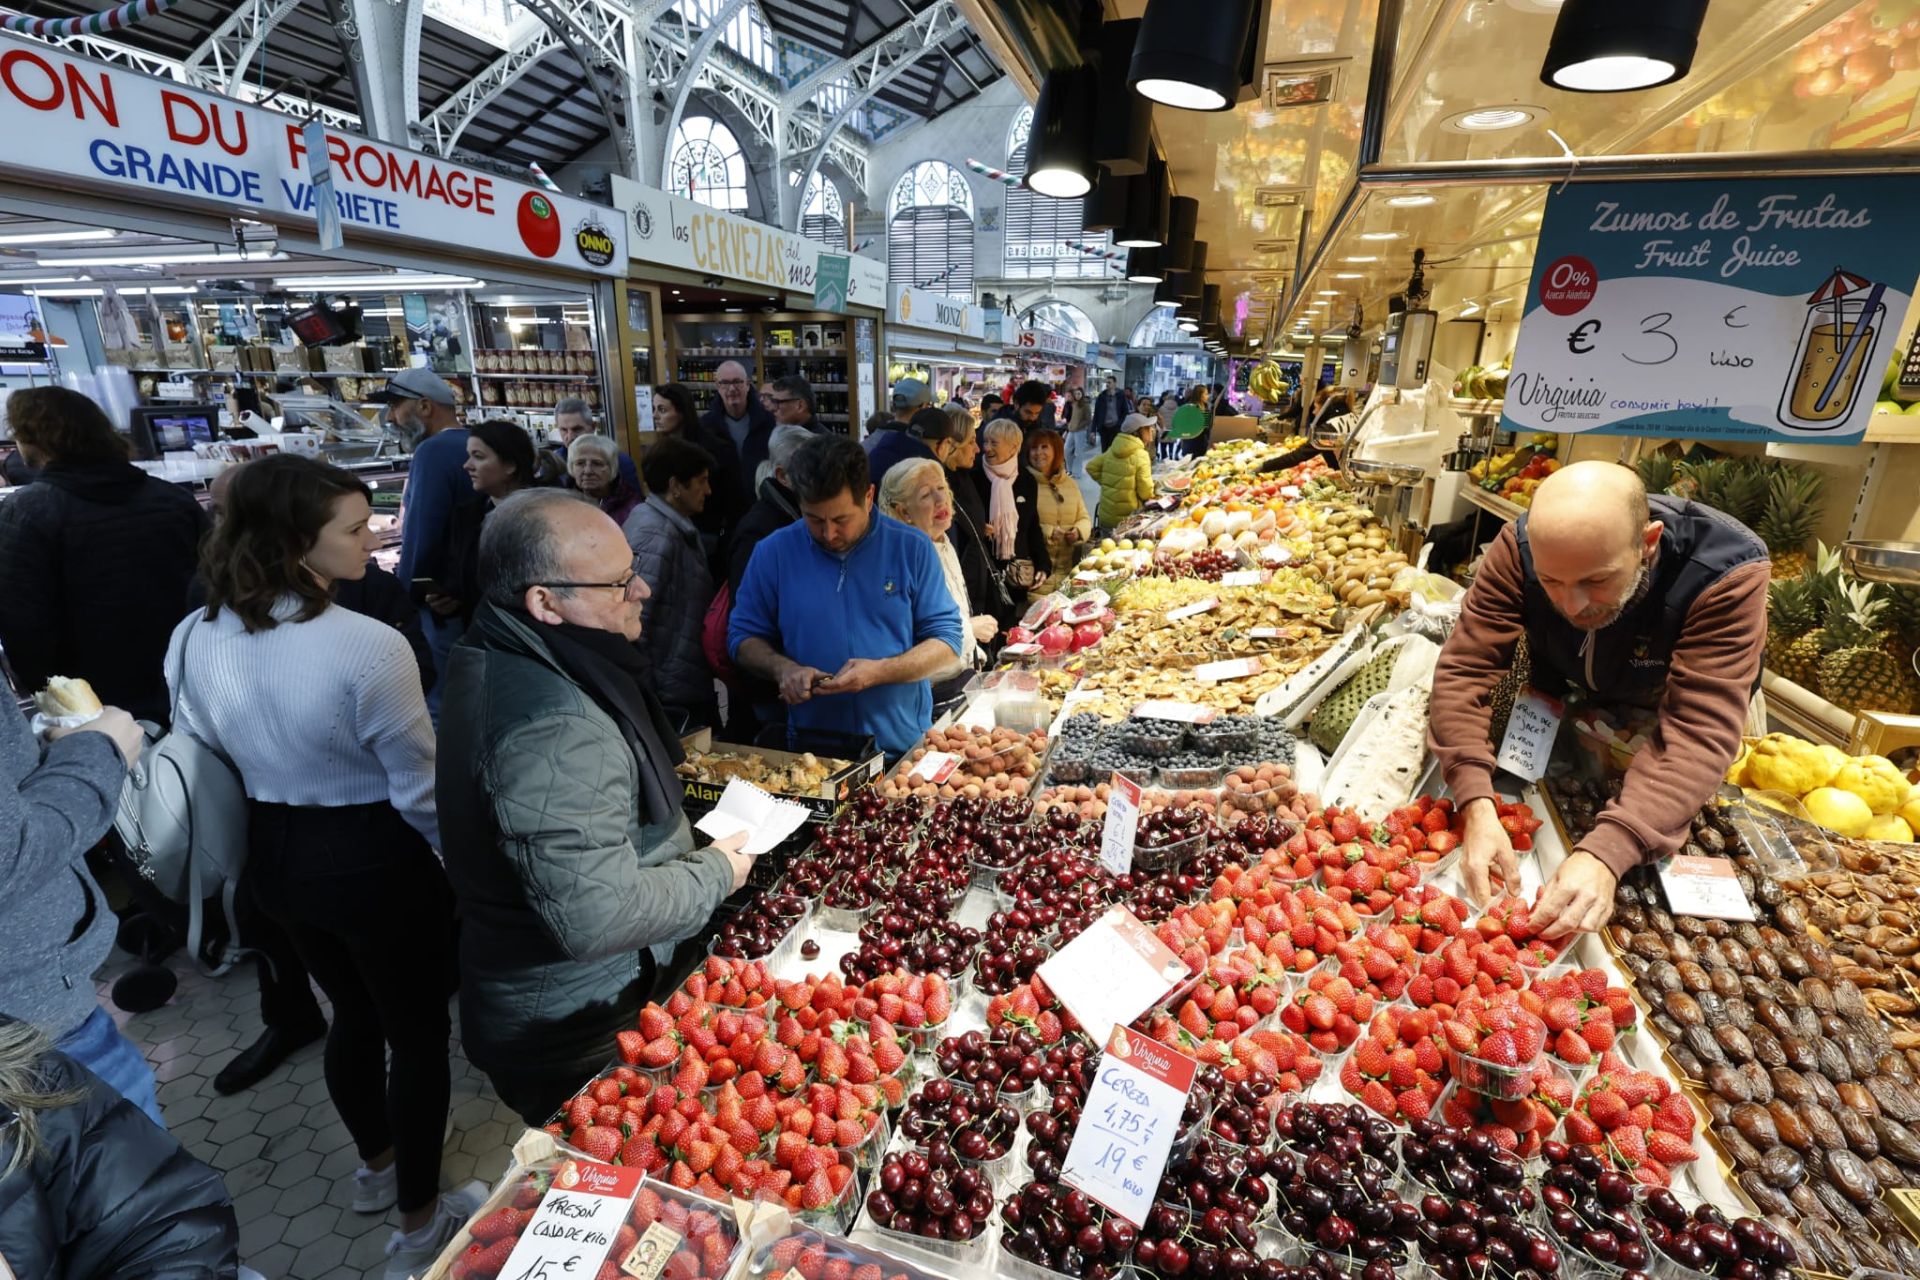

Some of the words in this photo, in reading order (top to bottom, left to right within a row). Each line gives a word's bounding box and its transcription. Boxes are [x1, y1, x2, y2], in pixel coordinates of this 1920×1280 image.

[161, 90, 248, 156] DU
[286, 124, 495, 216] FROMAGE
[89, 139, 264, 203] GRANDE
[1589, 201, 1692, 232] Zumos
[1698, 193, 1741, 231] de
[1747, 193, 1872, 232] Frutas
[579, 232, 612, 253] ONNO
[669, 201, 689, 242] las
[691, 213, 785, 286] CERVEZAS
[785, 240, 801, 261] del
[1635, 239, 1711, 269] Fruit
[1720, 235, 1802, 278] Juice
[1551, 263, 1590, 289] 0%
[1567, 318, 1602, 354] €
[1621, 312, 1678, 365] 3
[1723, 305, 1750, 328] €
[1510, 373, 1606, 422] Virginia
[1131, 1037, 1172, 1070] Virginia
[1104, 1102, 1145, 1133] 4,75
[1095, 1142, 1127, 1174] 19
[1132, 1155, 1148, 1171] €
[581, 1165, 619, 1191] Virginia
[563, 1255, 582, 1272] €
